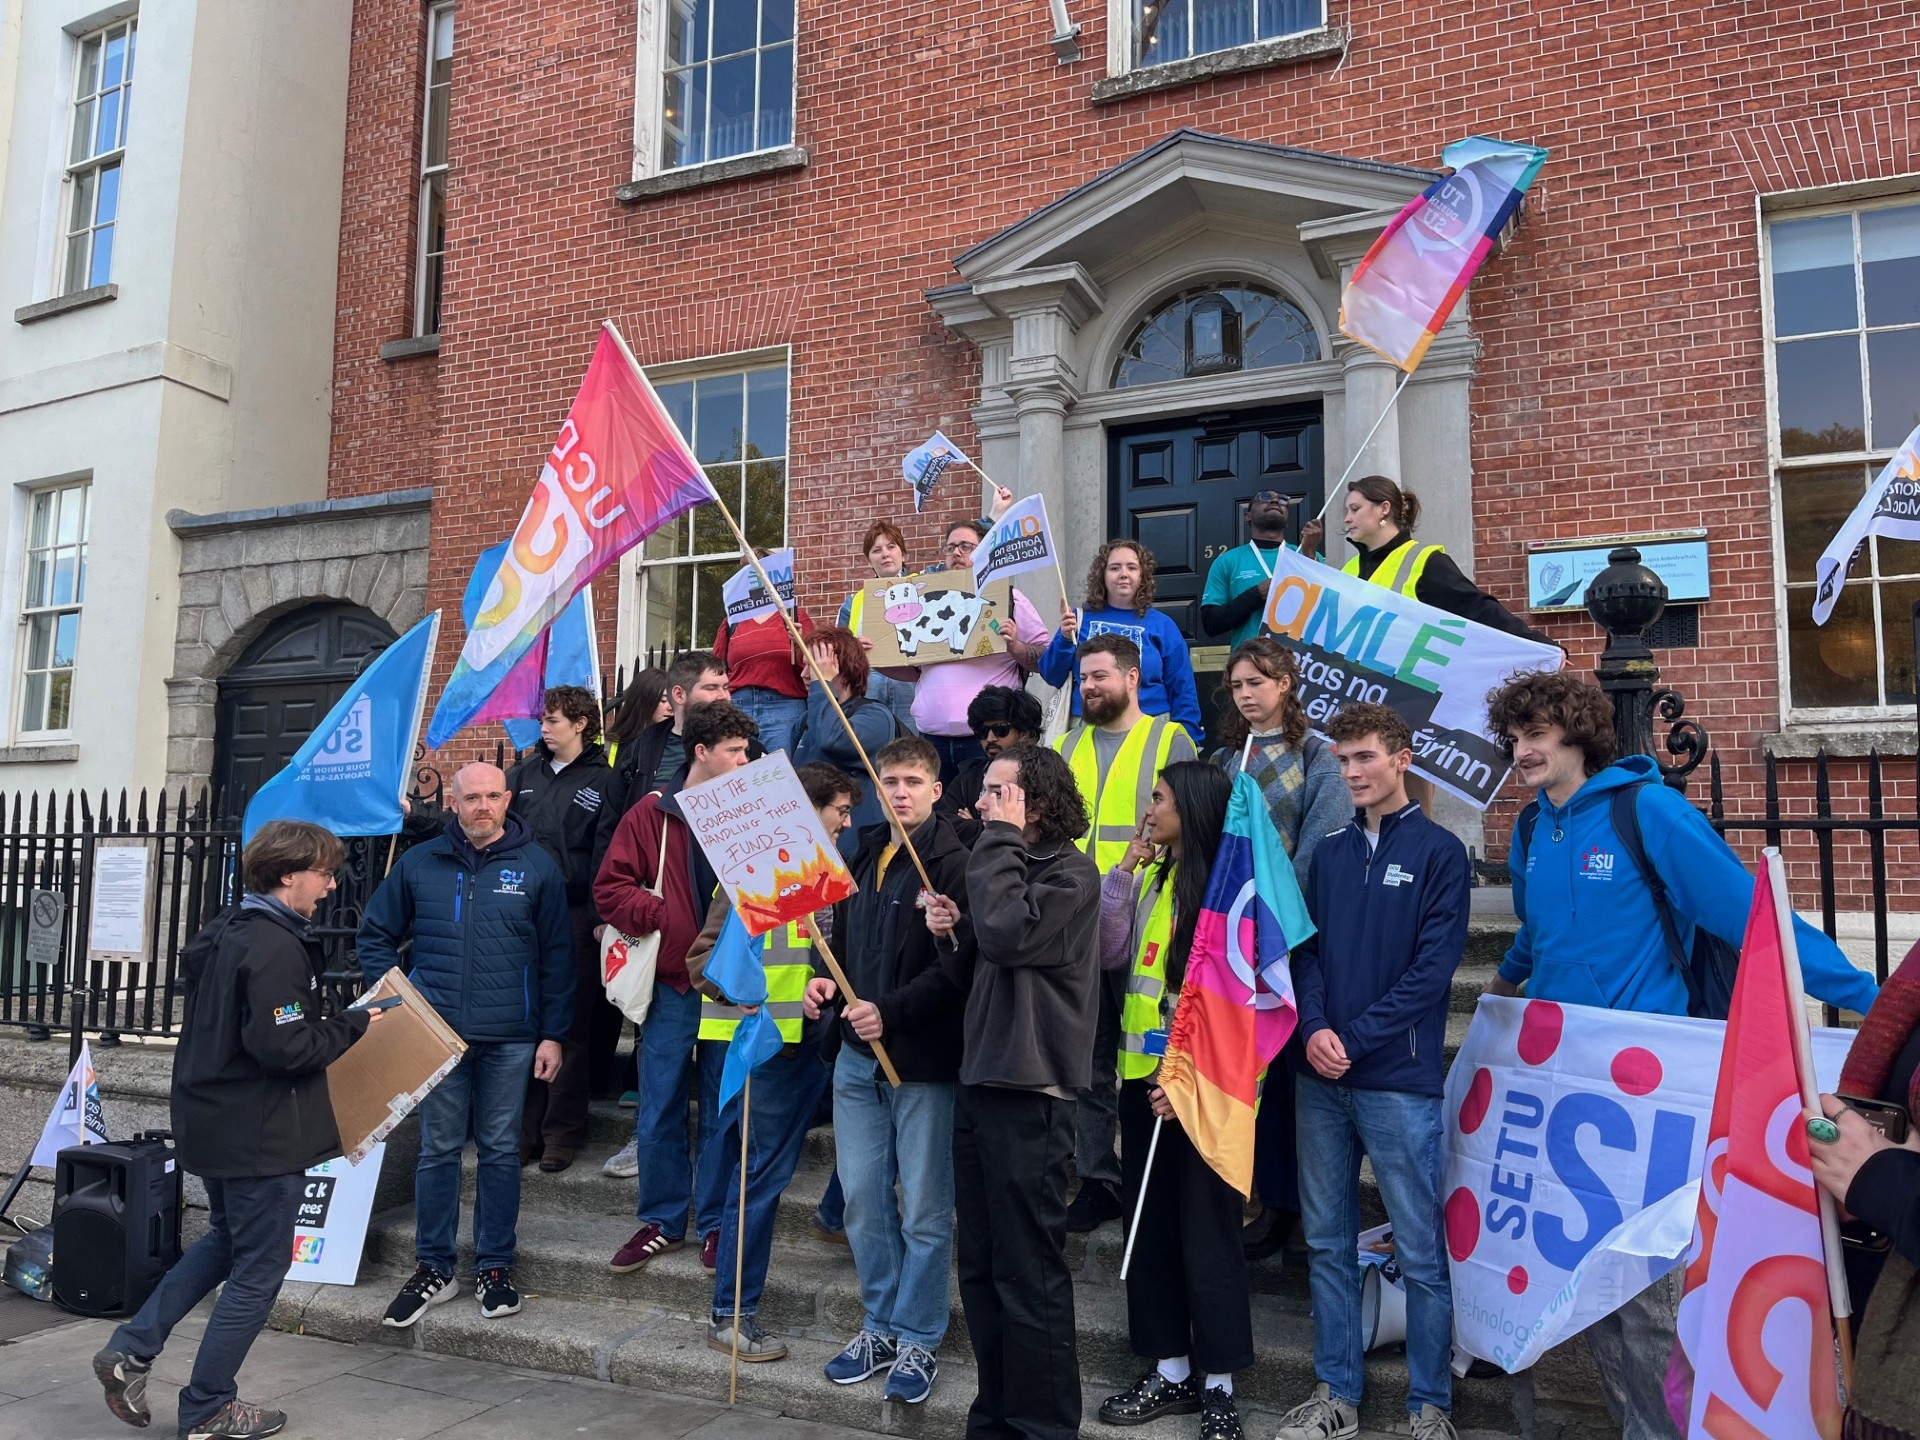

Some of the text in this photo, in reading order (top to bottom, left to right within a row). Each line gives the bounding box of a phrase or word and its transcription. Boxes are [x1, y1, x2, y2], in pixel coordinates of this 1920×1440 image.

[685, 787, 726, 814] POV:
[723, 777, 748, 799] THE
[696, 797, 766, 833] GOVERNMENT
[701, 799, 801, 848] HANDLING THEIR
[725, 826, 791, 863] FUNDS
[1595, 854, 1614, 870] SU
[500, 869, 525, 885] SU
[84, 1114, 106, 1134] éinn
[1485, 1089, 1545, 1241] SETU
[304, 1182, 328, 1198] CK
